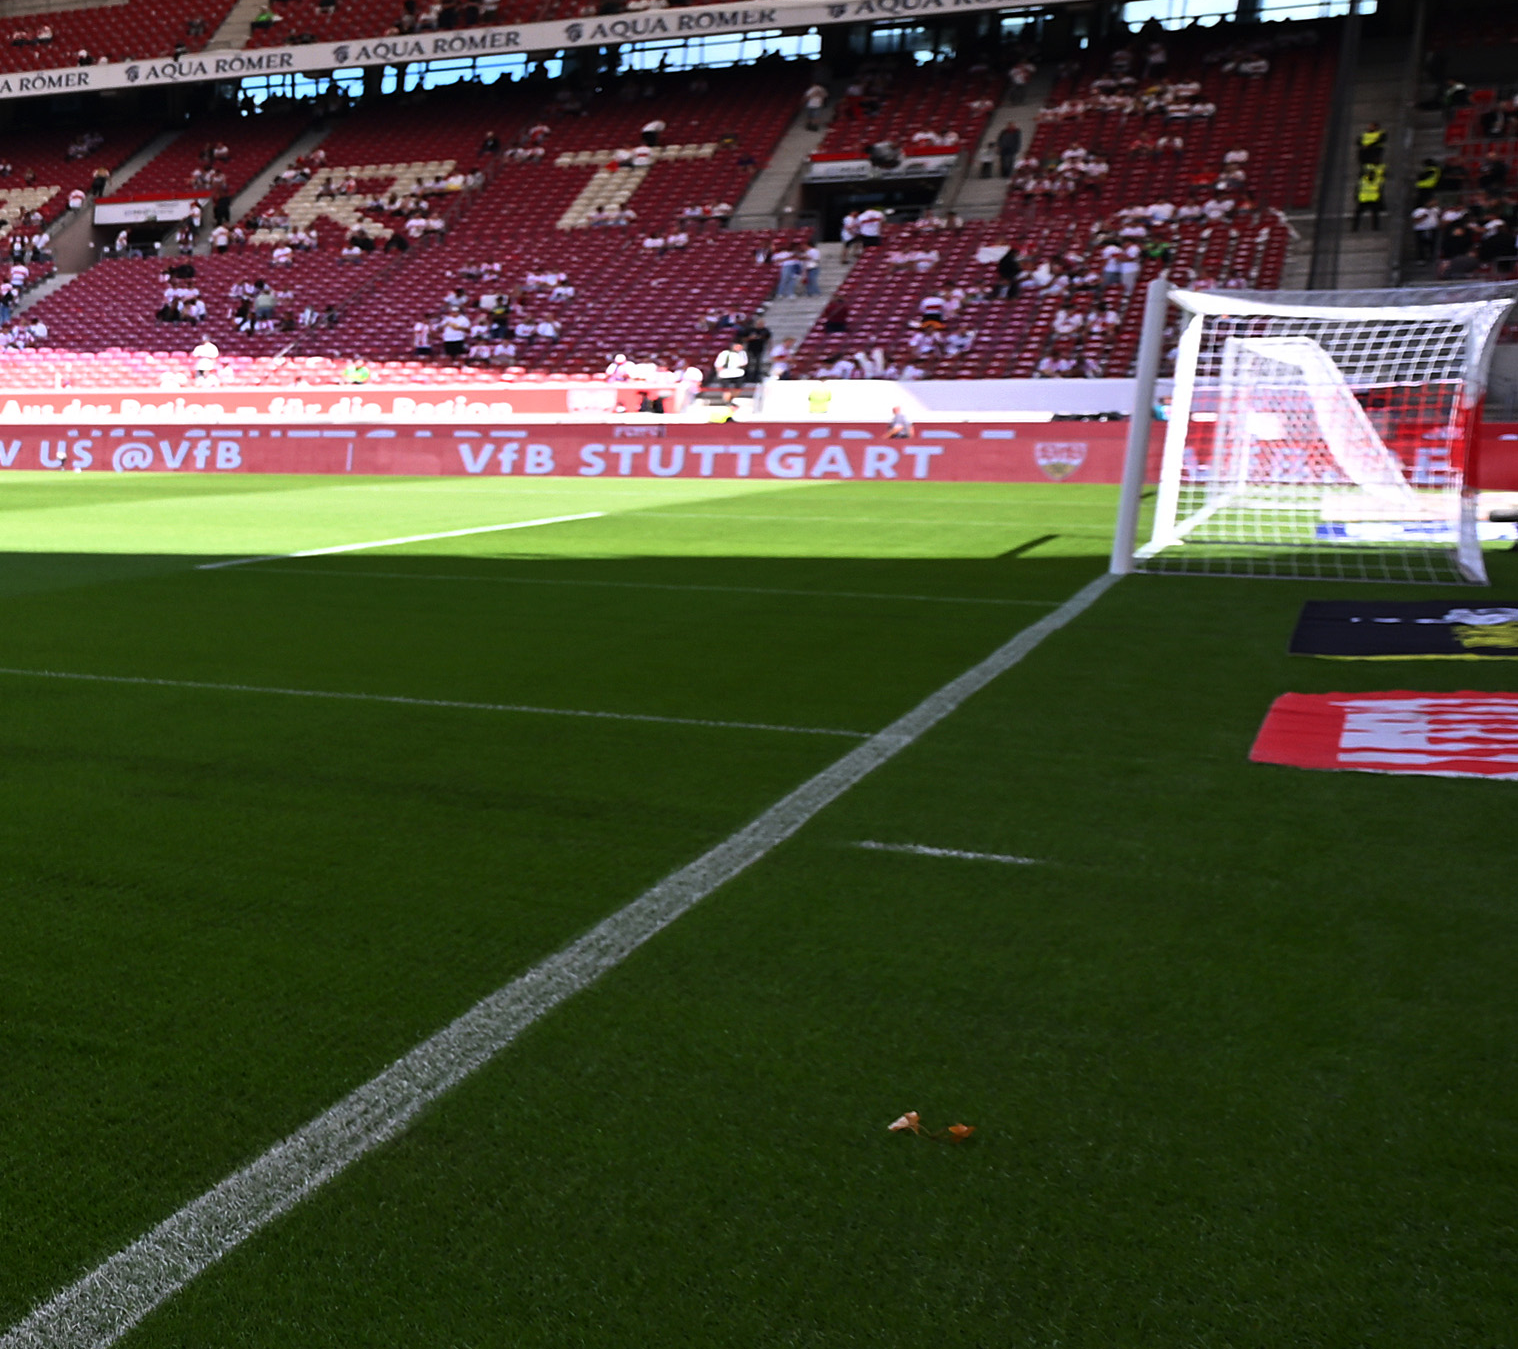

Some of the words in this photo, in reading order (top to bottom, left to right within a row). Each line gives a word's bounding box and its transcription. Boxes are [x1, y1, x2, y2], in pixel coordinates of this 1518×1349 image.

[590, 17, 668, 40] AQUA
[355, 38, 425, 60] AQUA
[433, 28, 520, 53] RÖMER
[146, 60, 208, 81] AQUA
[215, 52, 294, 74] RÖMER
[19, 72, 90, 92] RÖMER
[40, 440, 94, 469] US
[112, 440, 242, 472] @VfB
[457, 442, 556, 475] VfB
[579, 444, 945, 479] STUTTGART
